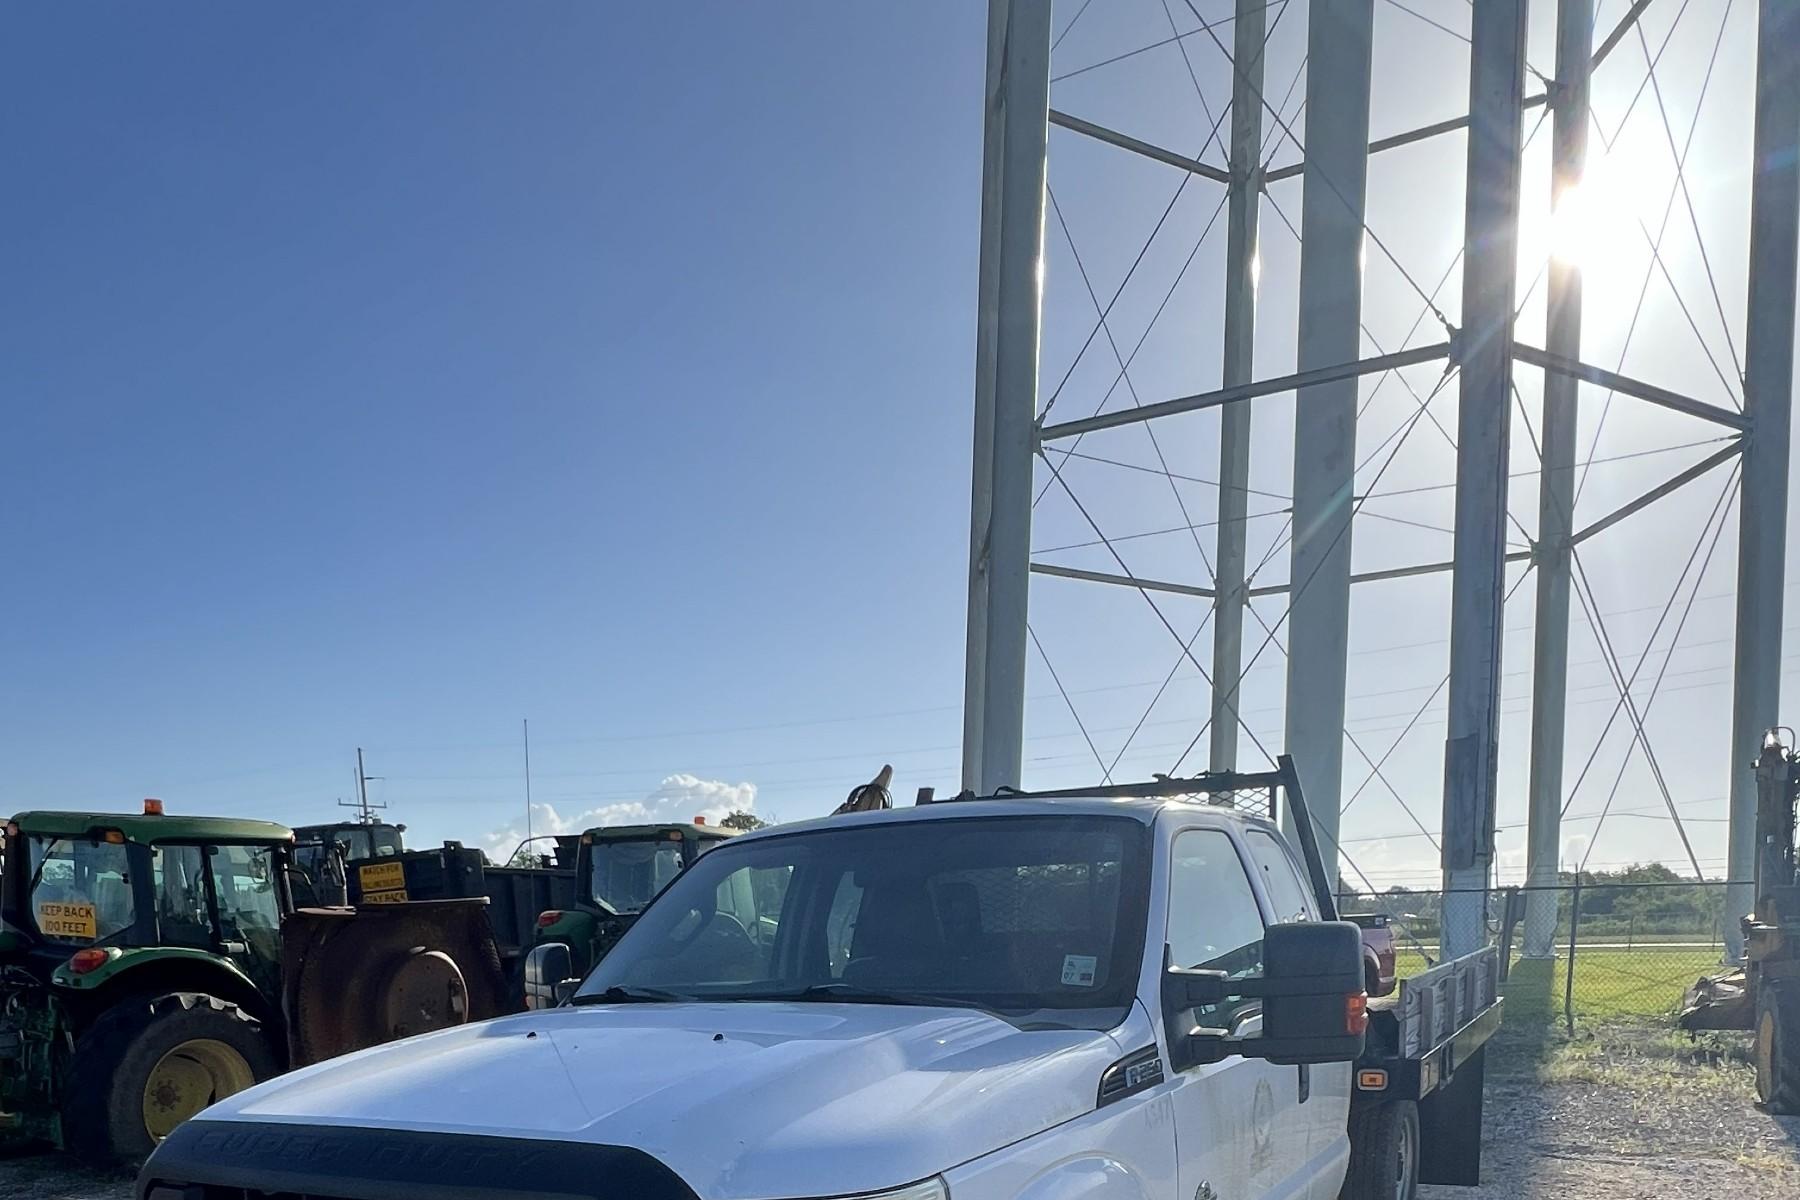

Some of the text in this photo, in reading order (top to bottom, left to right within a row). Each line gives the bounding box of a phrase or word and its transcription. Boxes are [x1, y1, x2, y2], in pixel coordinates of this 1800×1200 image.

[41, 905, 93, 918] KEEP BACK
[45, 920, 87, 933] 100 FEET
